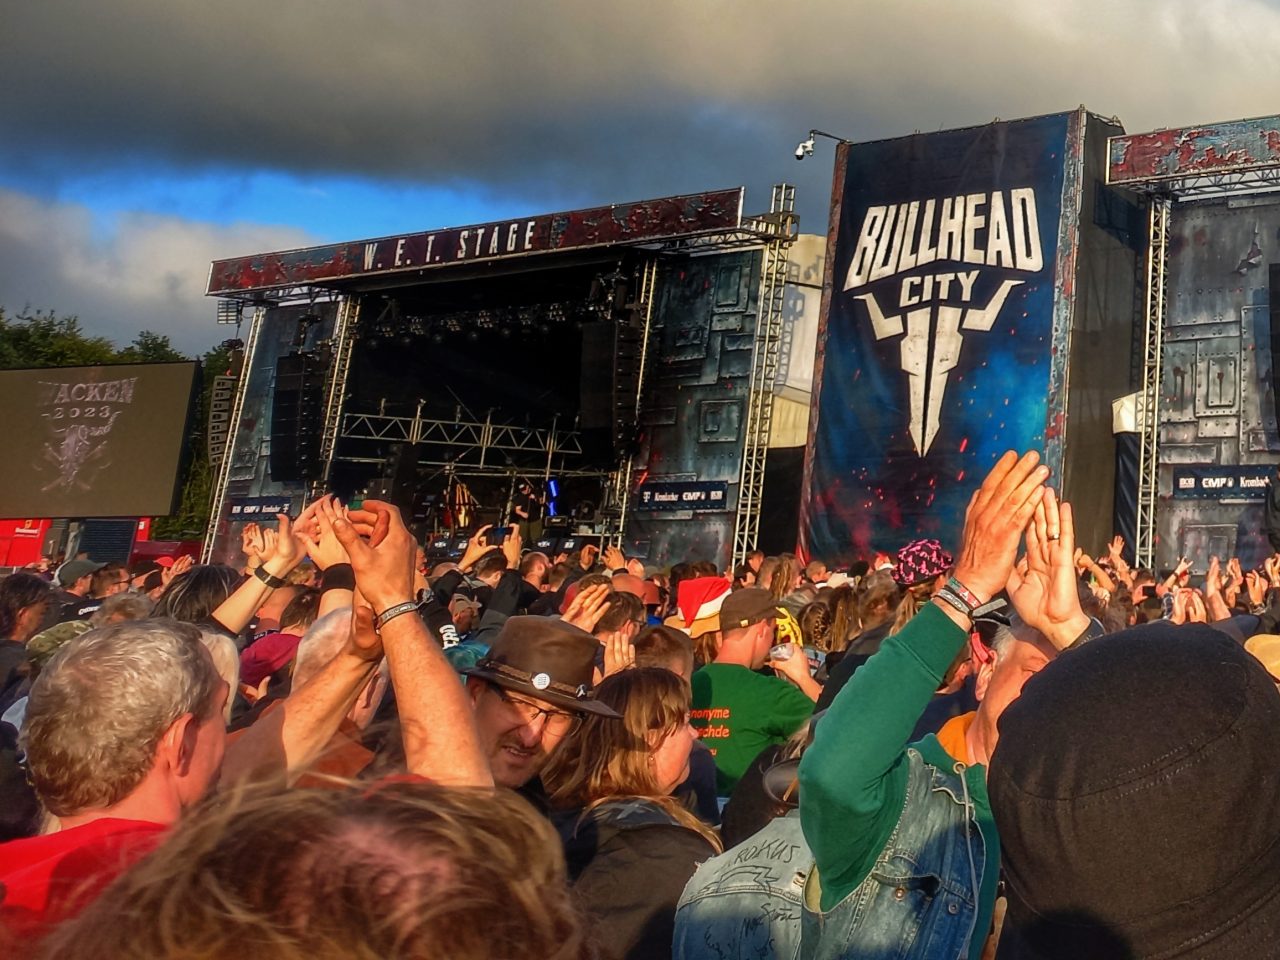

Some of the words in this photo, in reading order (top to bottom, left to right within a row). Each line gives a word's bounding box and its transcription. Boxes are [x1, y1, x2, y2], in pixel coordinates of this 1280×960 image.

[457, 221, 536, 259] STAGE
[842, 187, 1044, 292] BULLHEAD
[899, 269, 980, 308] CITY
[38, 377, 139, 404] ACKEN
